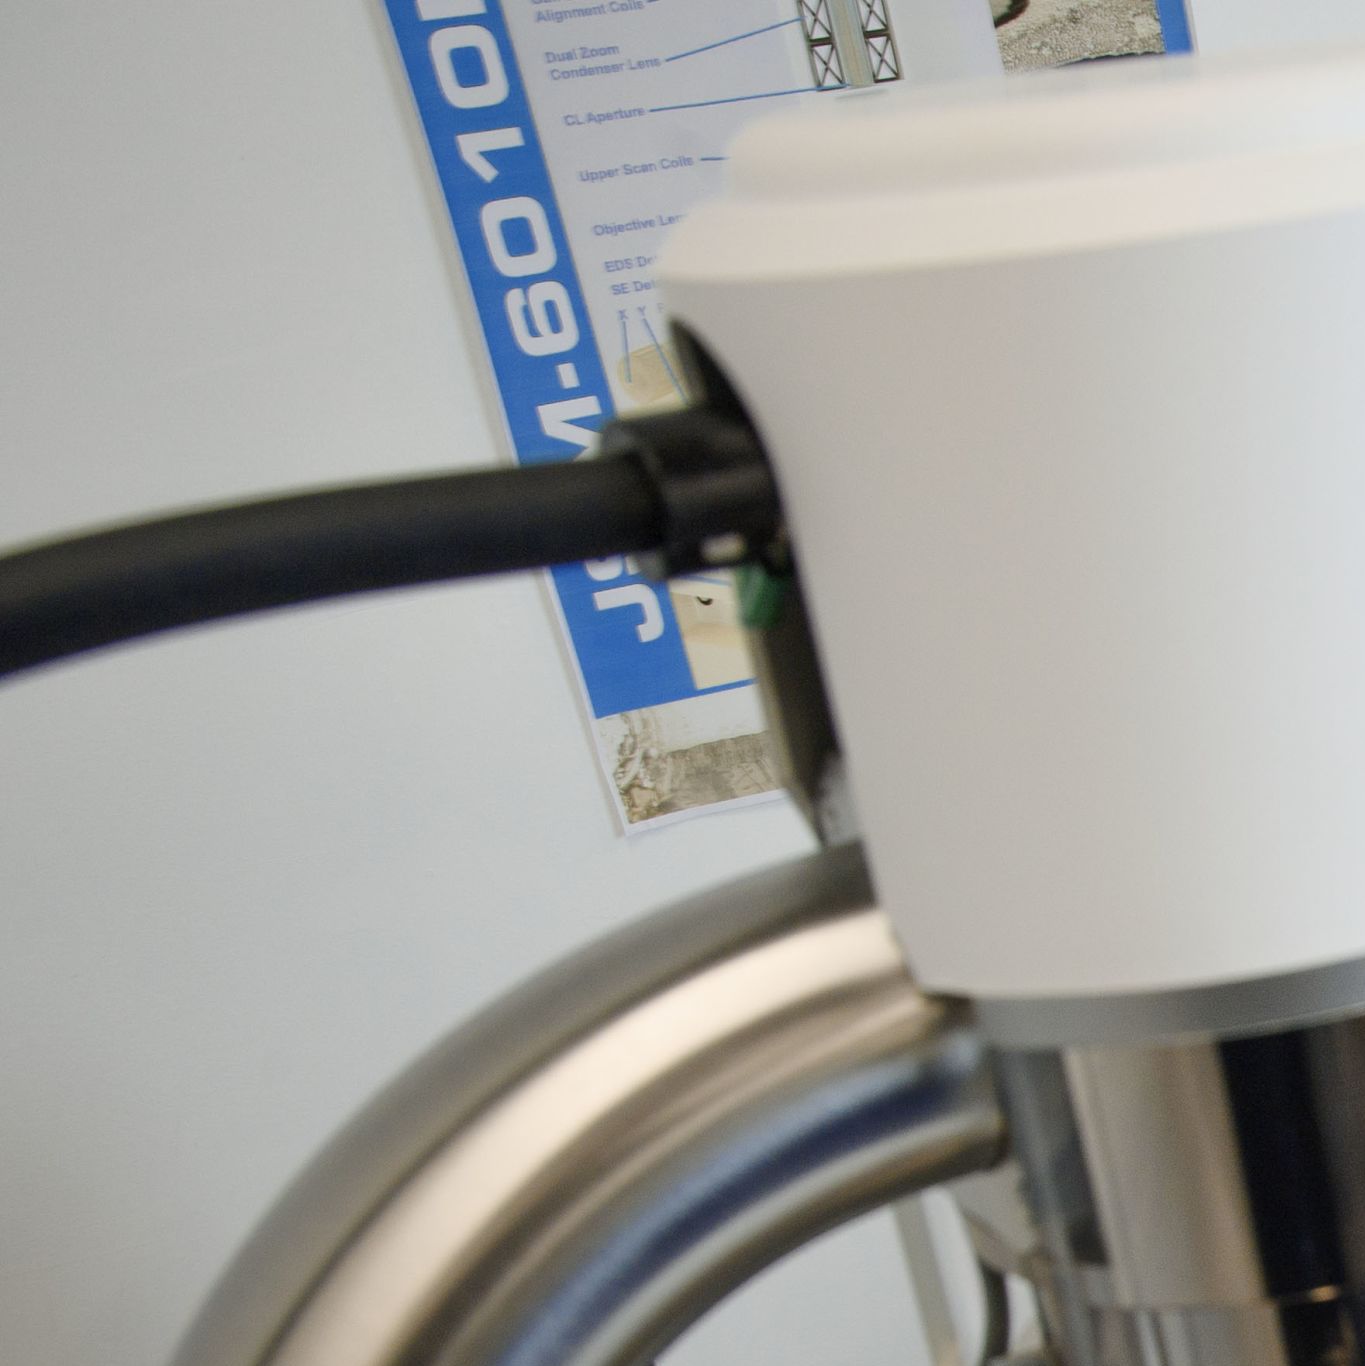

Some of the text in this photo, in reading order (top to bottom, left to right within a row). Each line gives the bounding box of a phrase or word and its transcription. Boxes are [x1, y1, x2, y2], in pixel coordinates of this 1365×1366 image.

[535, 4, 606, 23] Alignment
[545, 45, 620, 64] Dual Zoom
[549, 57, 662, 81] Condenser Lens
[563, 106, 646, 126] CL Aperture
[579, 155, 694, 183] Upper Scan Coils
[592, 217, 656, 236] Objective
[604, 258, 634, 272] EDS
[611, 284, 631, 296] SE
